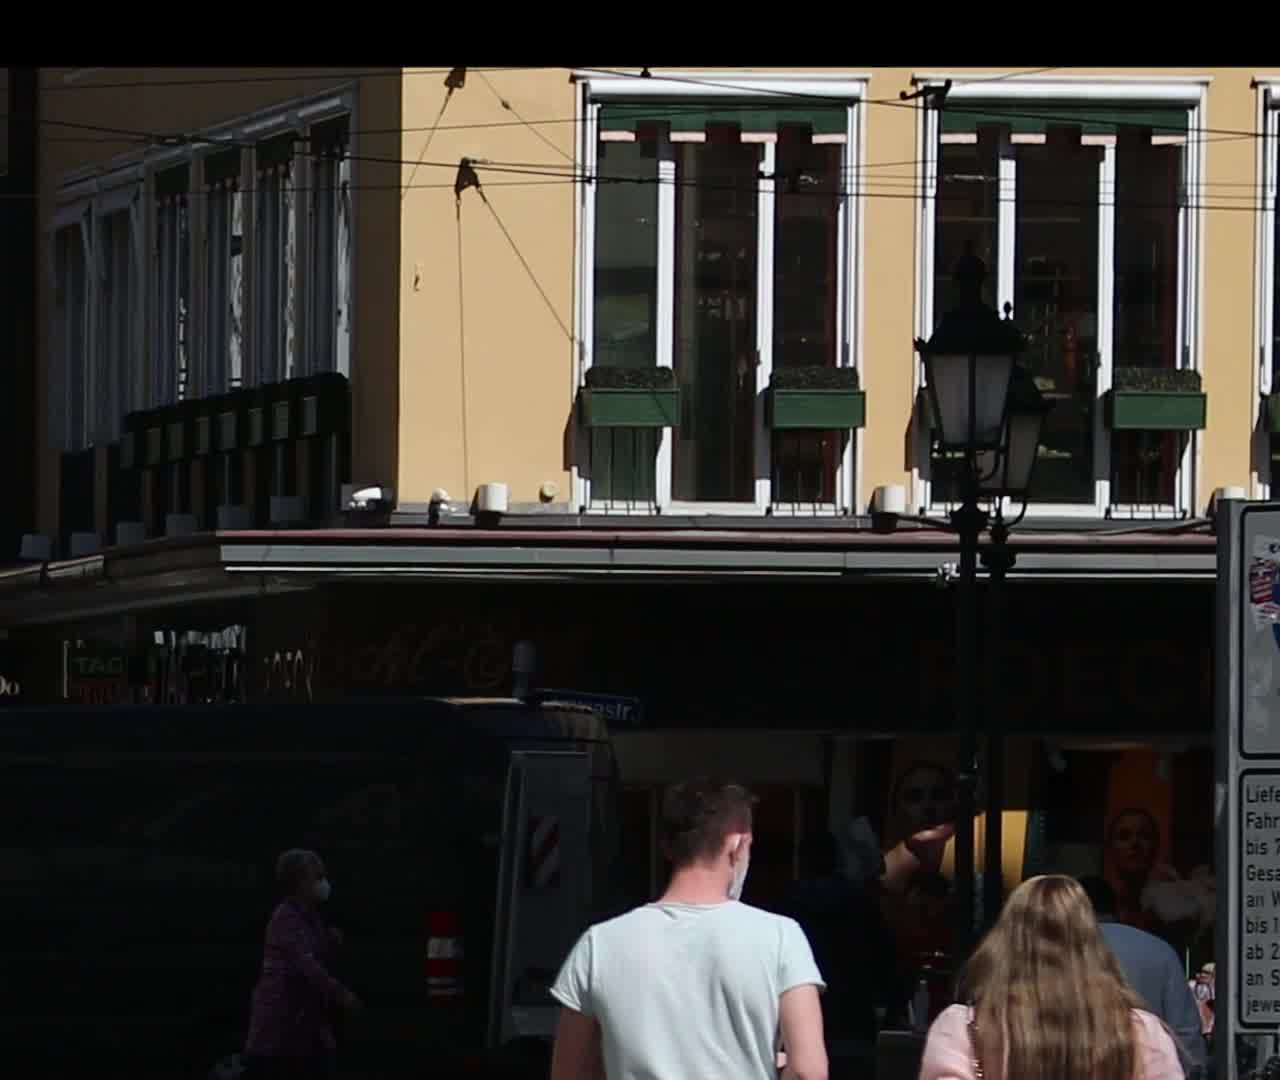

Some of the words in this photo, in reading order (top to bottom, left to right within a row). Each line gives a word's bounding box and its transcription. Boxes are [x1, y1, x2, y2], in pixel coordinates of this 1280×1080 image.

[1246, 839, 1268, 855] bis
[1246, 895, 1265, 907] an
[1246, 917, 1268, 934] bis
[1246, 943, 1265, 960] ab
[1246, 973, 1265, 986] an
